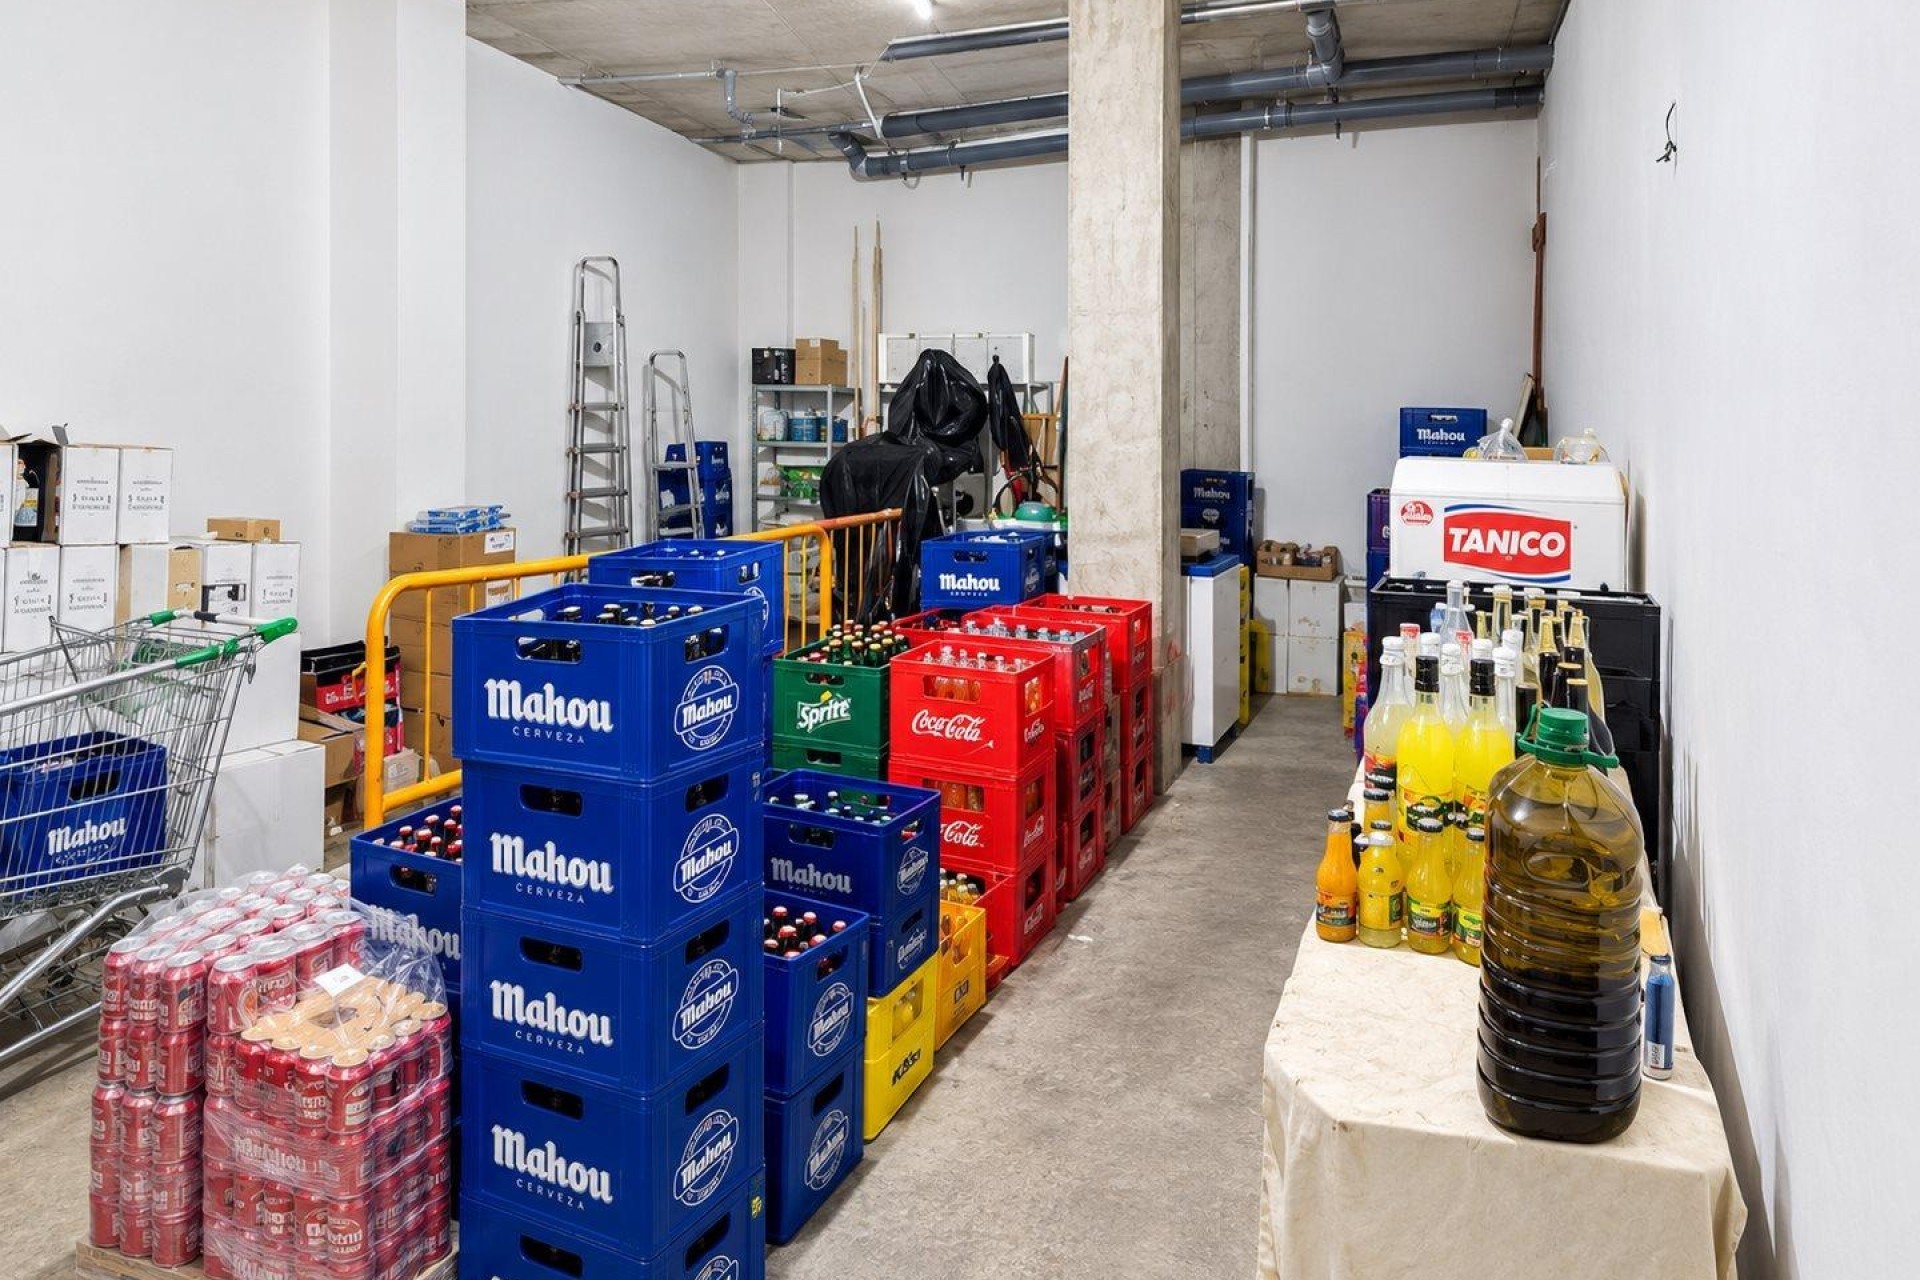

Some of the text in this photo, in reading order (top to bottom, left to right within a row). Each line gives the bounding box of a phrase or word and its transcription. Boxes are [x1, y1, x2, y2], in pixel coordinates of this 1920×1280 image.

[1416, 428, 1465, 441] Mahou
[1448, 527, 1566, 557] TANICO
[939, 573, 1000, 591] Mahou
[484, 678, 614, 733] Mahou
[682, 695, 732, 728] Mahou
[796, 698, 851, 733] Sprite
[512, 725, 585, 744] CERVEZA
[48, 817, 126, 856] Mahou
[490, 832, 614, 894] Mahou
[680, 840, 732, 883] Mahou
[771, 857, 853, 894] Mahou
[515, 882, 585, 904] CERVEZA
[367, 904, 460, 960] Mahou
[490, 979, 614, 1047] Mahou
[680, 981, 732, 1030] Mahou
[515, 1030, 585, 1055] CERVEZA
[492, 1124, 613, 1204] Mahou
[681, 1131, 732, 1189] Mahou
[516, 1178, 585, 1210] CERVEZA
